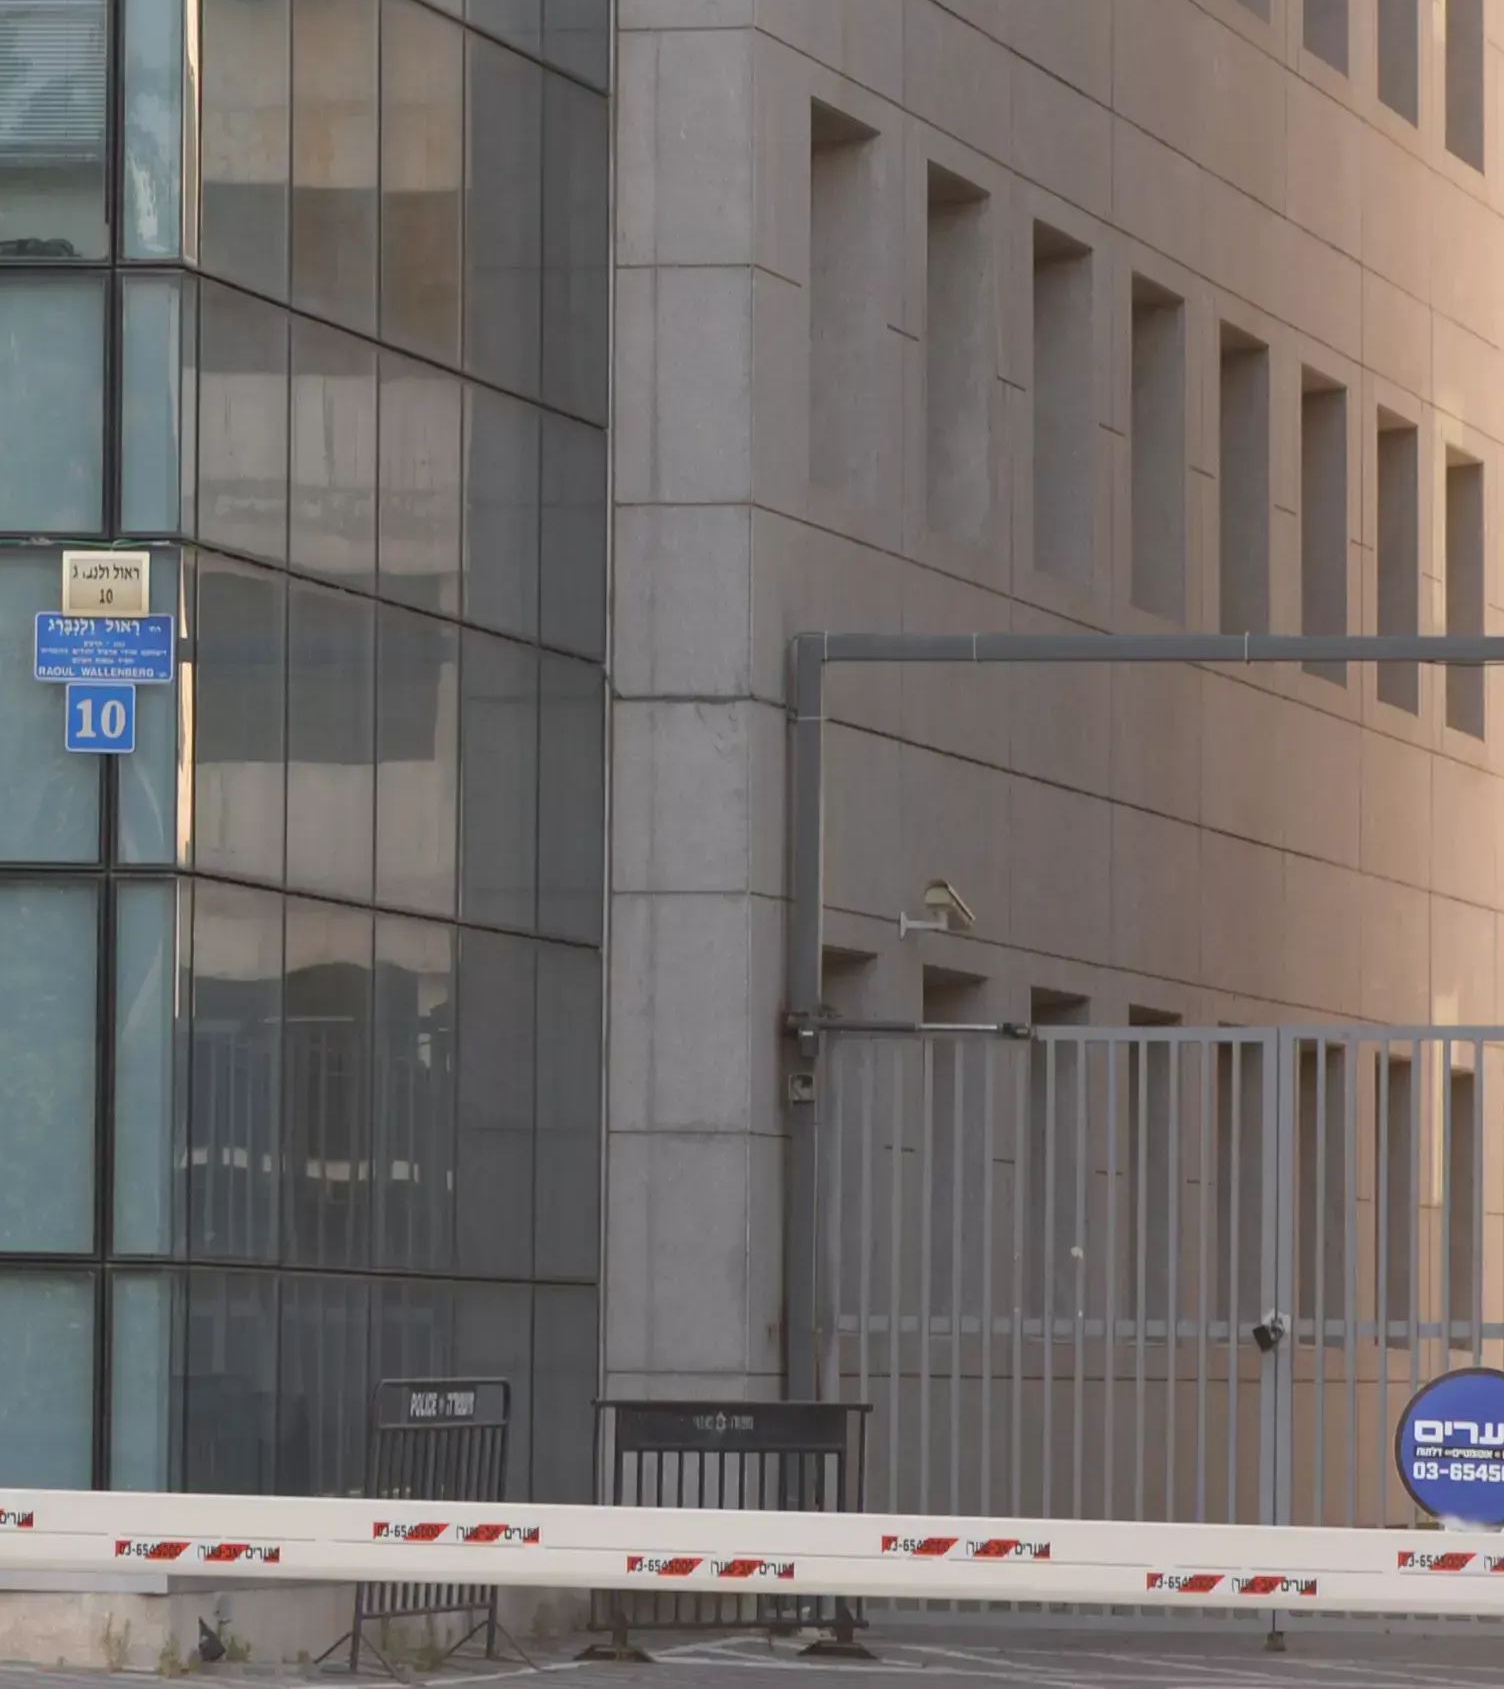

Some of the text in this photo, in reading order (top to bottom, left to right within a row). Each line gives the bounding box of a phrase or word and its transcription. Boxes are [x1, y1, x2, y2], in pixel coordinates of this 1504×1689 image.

[113, 563, 140, 580] ראול
[99, 588, 113, 604] 10
[38, 667, 75, 677] RAOUL
[81, 667, 154, 678] WALLENBERG
[75, 698, 126, 739] 10
[1413, 1461, 1504, 1482] 03-6545
